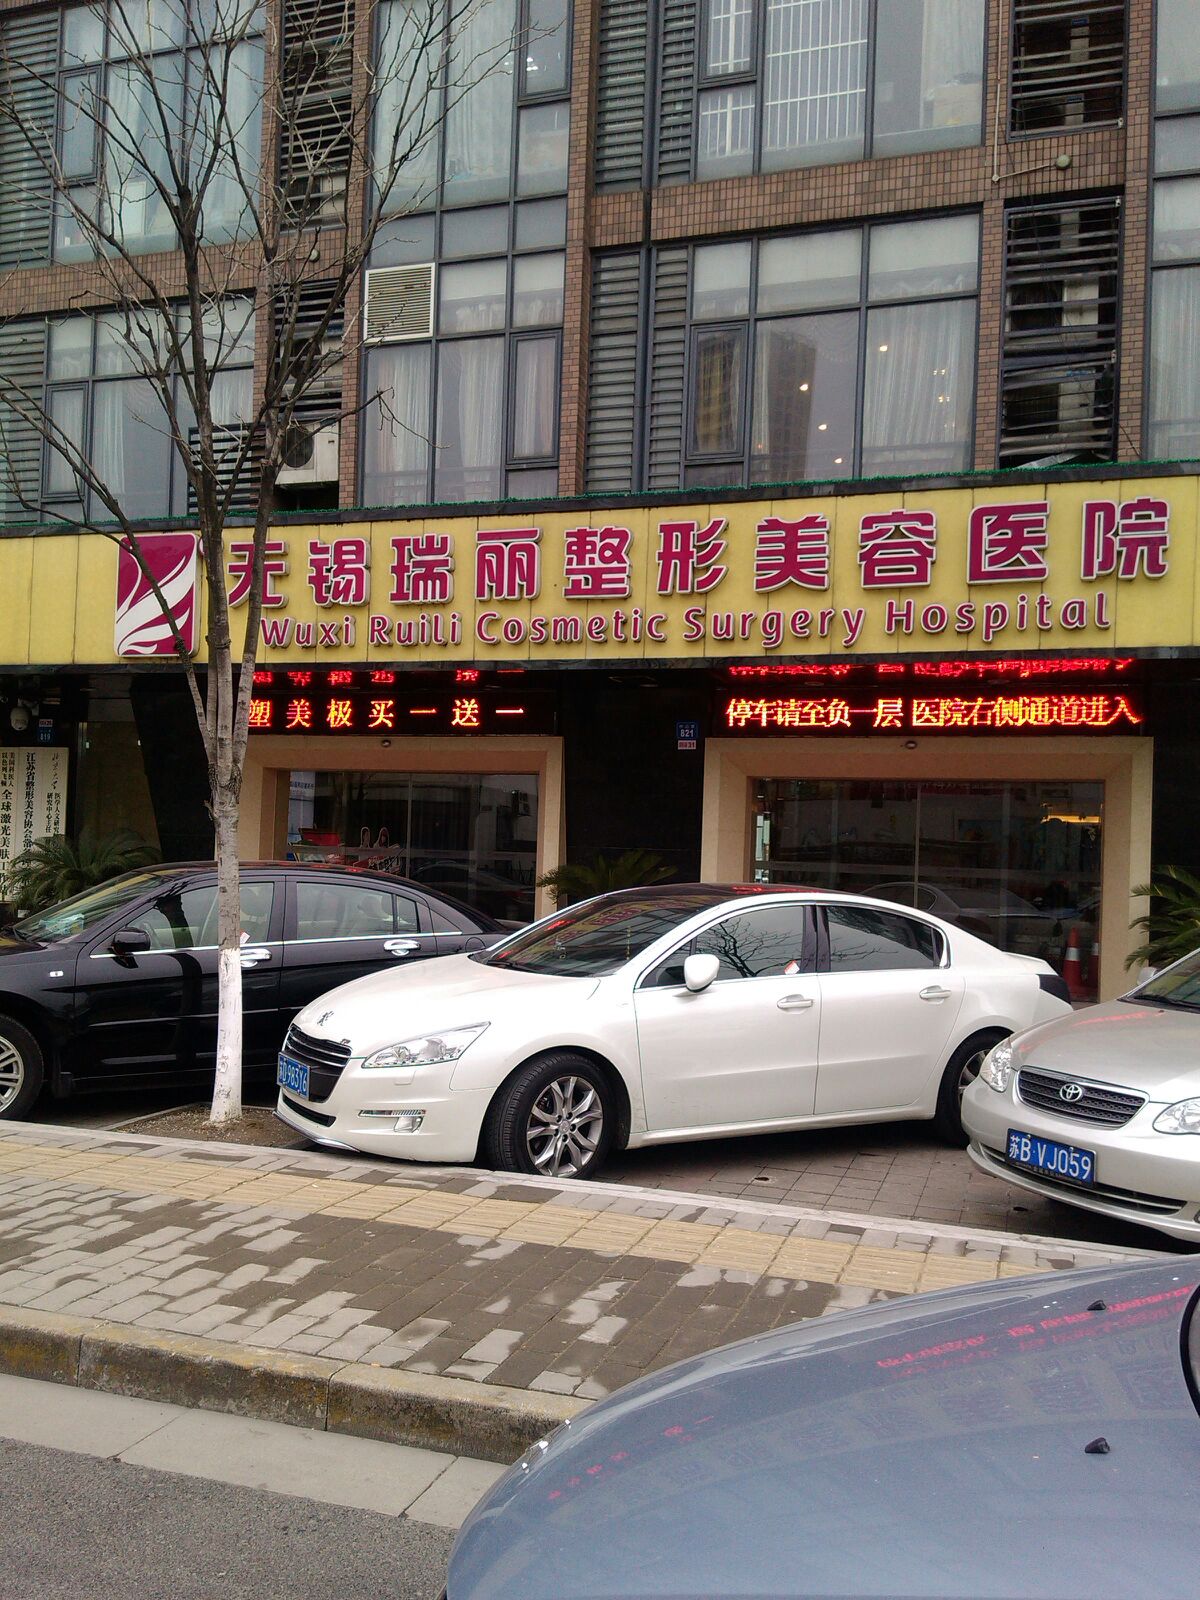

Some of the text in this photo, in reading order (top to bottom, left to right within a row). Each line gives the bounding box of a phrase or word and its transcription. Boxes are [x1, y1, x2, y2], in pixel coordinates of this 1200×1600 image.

[228, 496, 1169, 608] 无锡瑞丽整形美容医院
[260, 592, 1110, 649] Wuxi Ruili Cosmetic Surgery Hospital
[248, 699, 524, 728] 塑美极买一送一
[726, 696, 1142, 728] 停车请至负一层 医院右侧通道进入
[680, 728, 694, 738] 821
